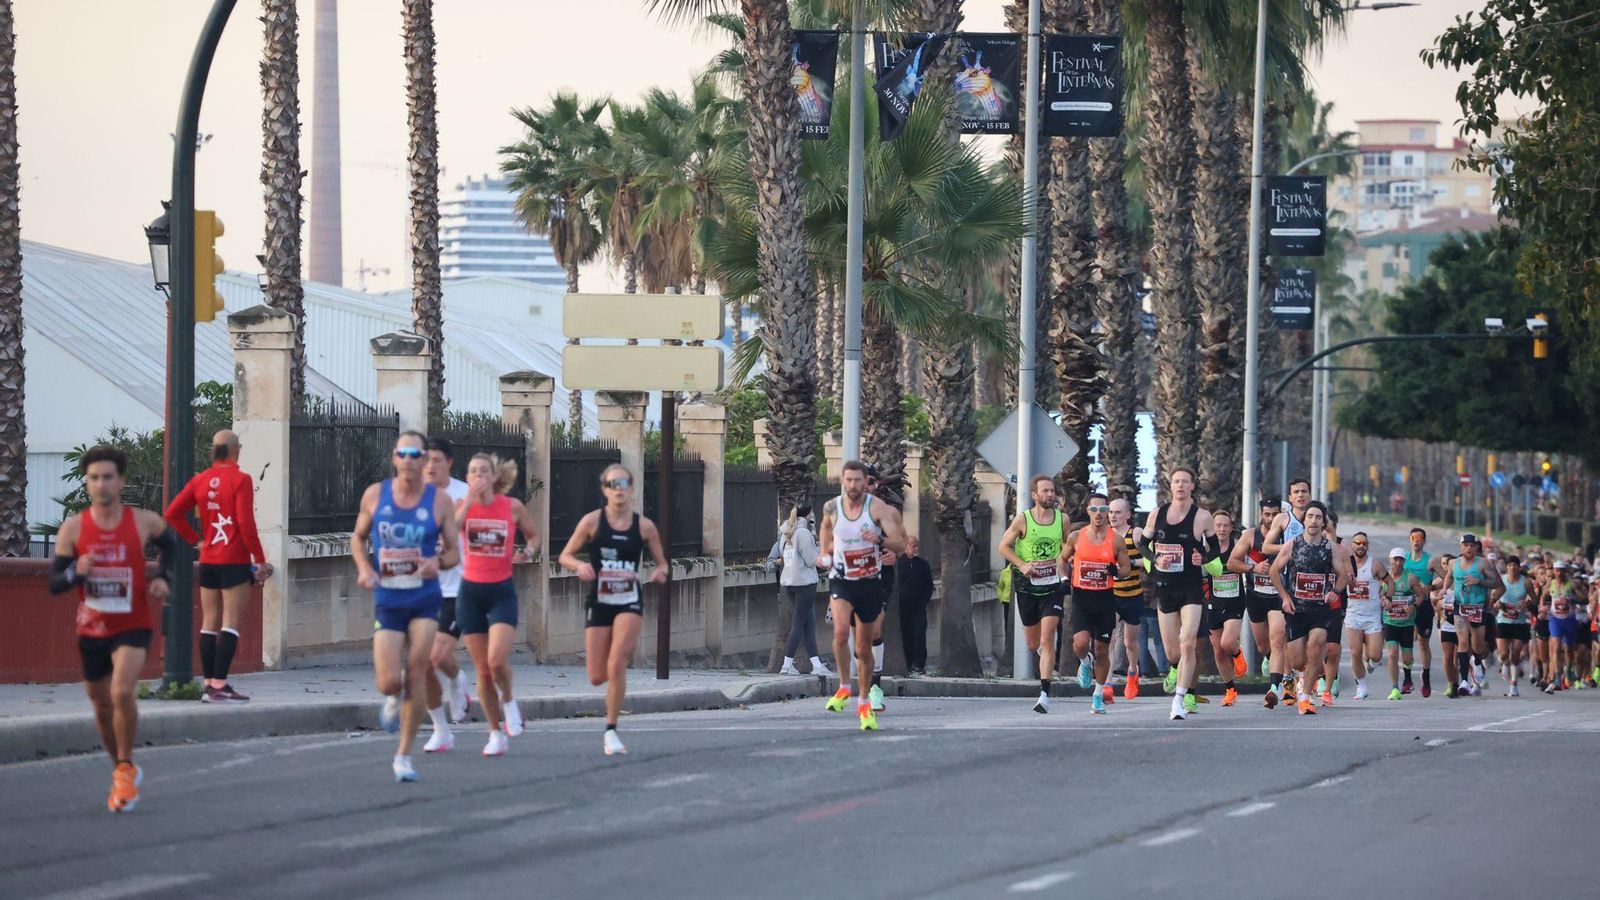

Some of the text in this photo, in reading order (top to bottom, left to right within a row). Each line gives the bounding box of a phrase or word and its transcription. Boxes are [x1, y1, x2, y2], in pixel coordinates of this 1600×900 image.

[1051, 51, 1106, 73] FESTIVAL
[1056, 71, 1115, 93] LINTERNAS
[883, 87, 908, 114] 30 NOV
[805, 125, 814, 133] 15
[961, 121, 980, 129] NOV
[1271, 188, 1315, 206] FESTIVAL
[1275, 204, 1322, 222] LINTERNAS
[378, 521, 426, 543] RCM
